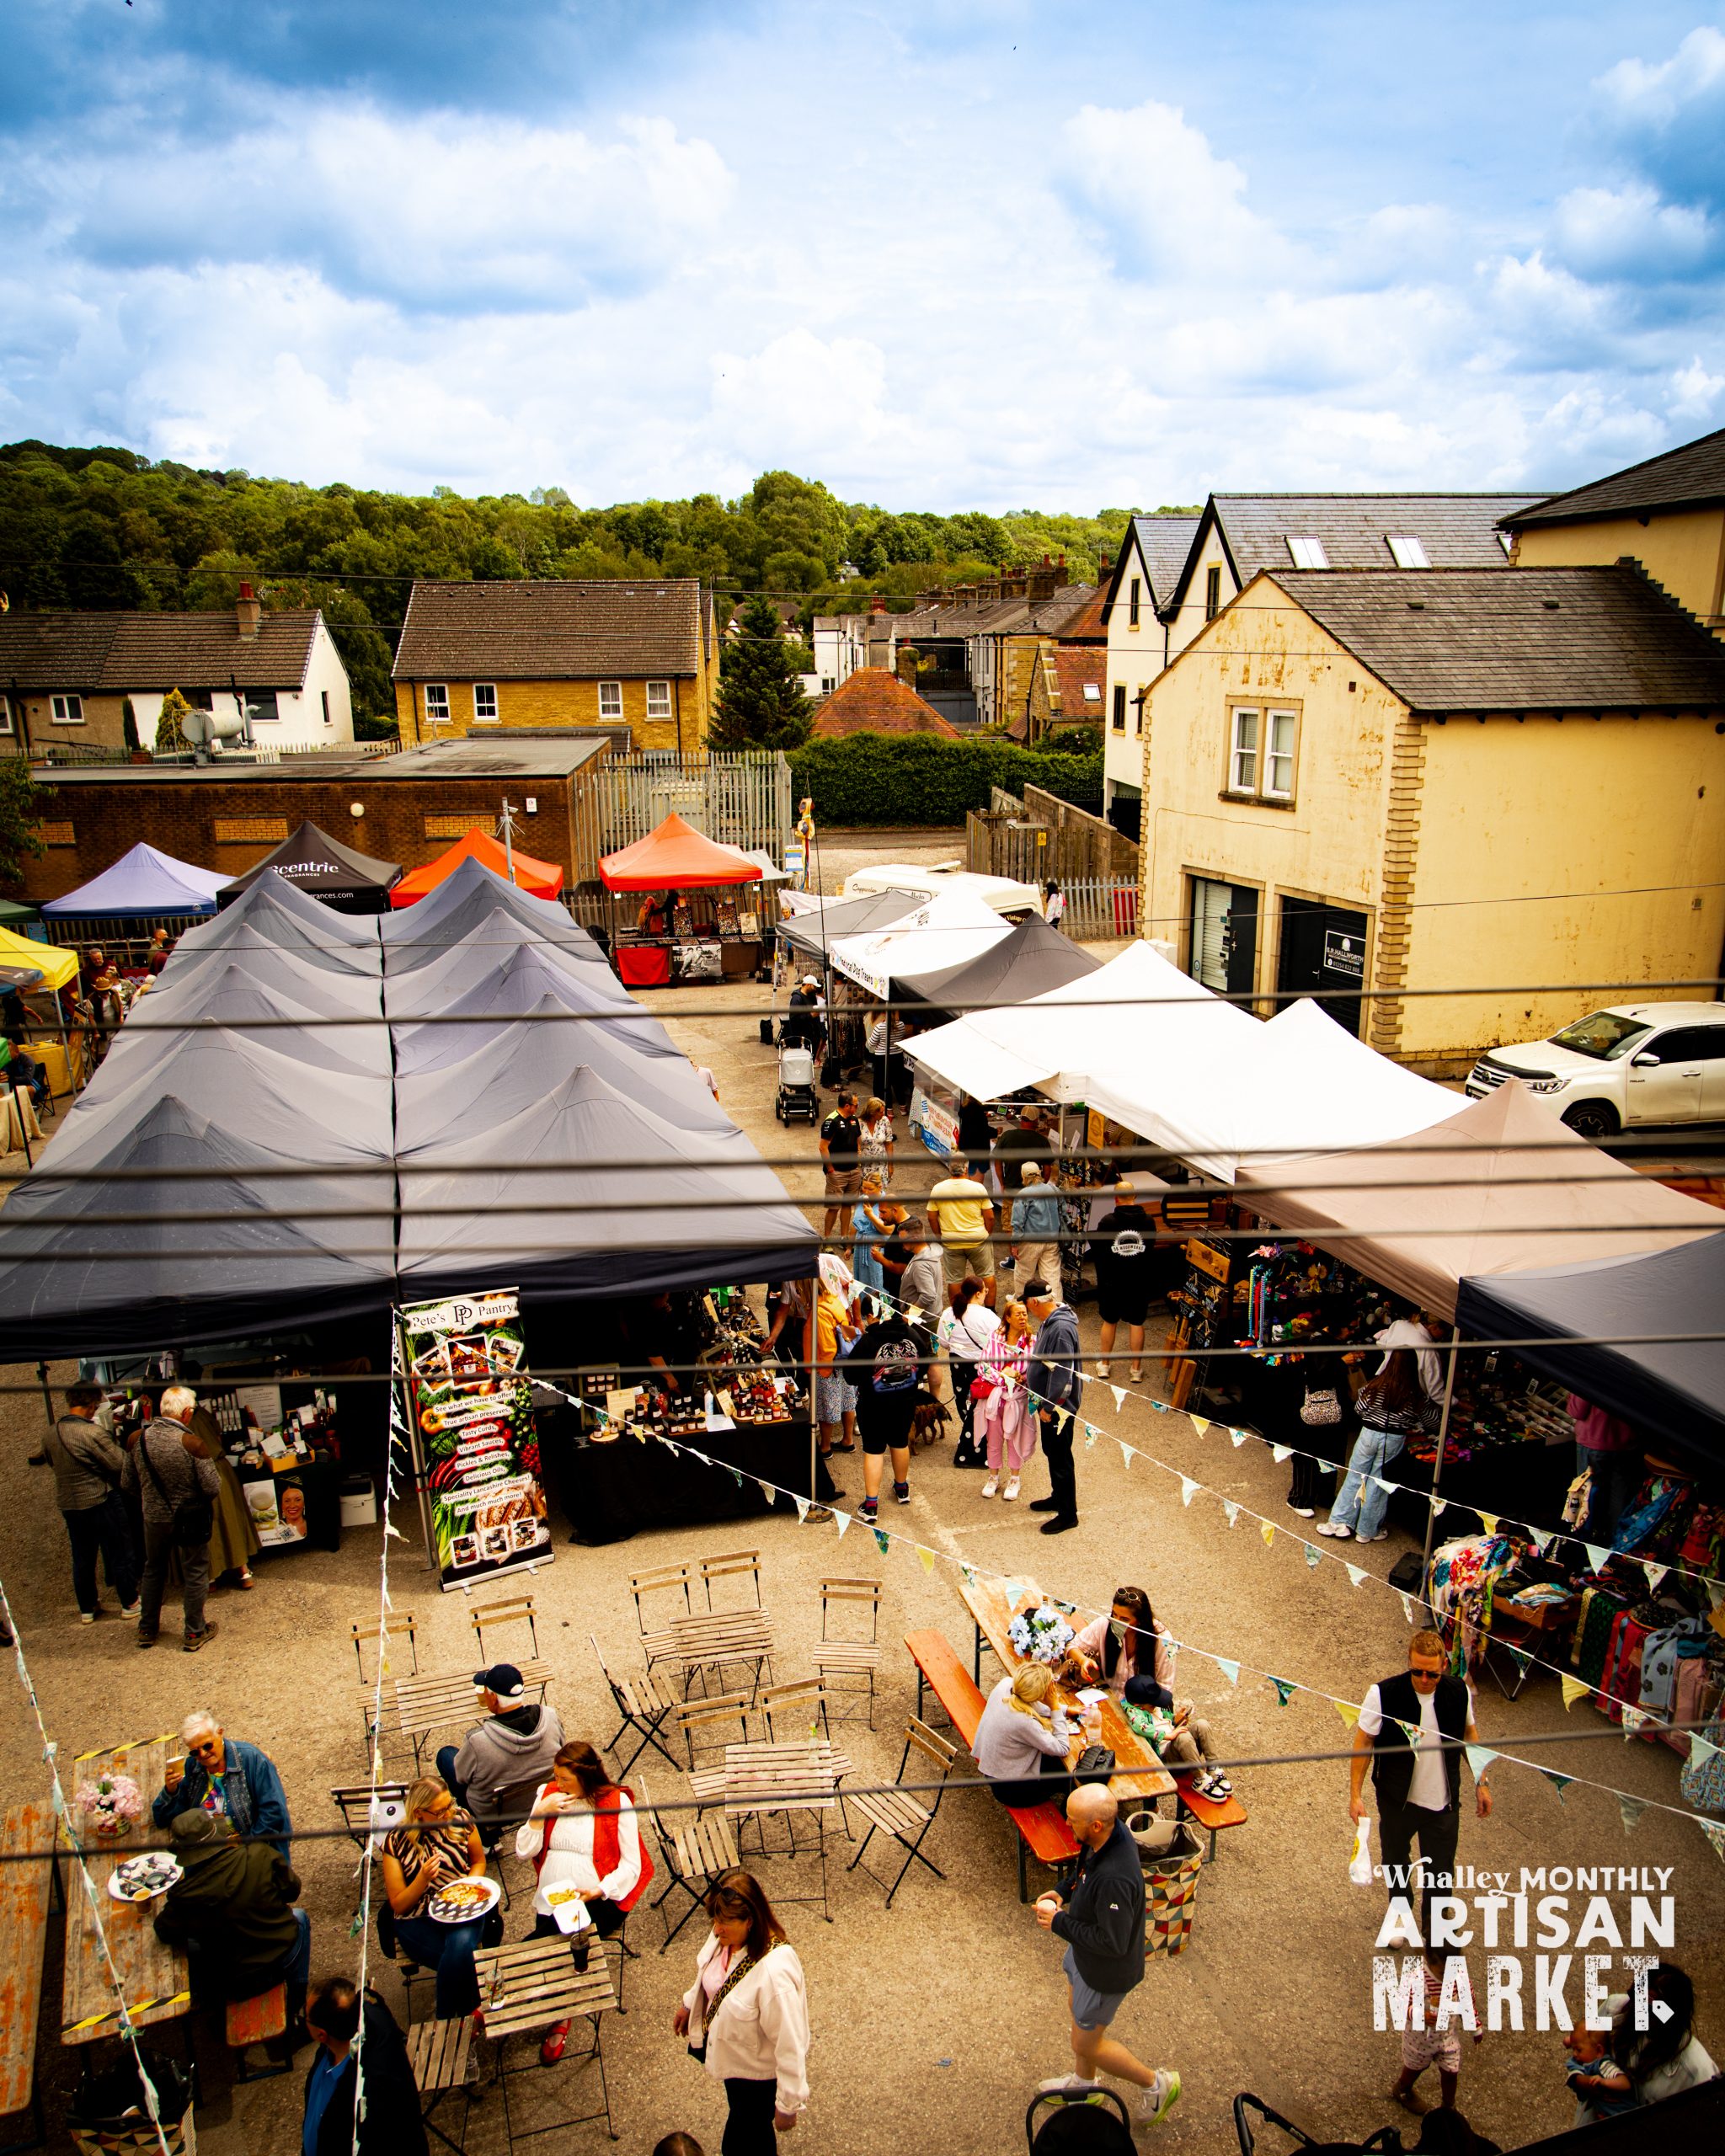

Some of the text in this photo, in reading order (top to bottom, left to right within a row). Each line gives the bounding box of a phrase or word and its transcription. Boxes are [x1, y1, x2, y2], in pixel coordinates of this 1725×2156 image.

[861, 968, 873, 985] Treats
[413, 1313, 446, 1327] Pete's
[478, 1303, 514, 1316] Pantry
[448, 1402, 463, 1411] what
[474, 1396, 489, 1405] have
[498, 1390, 514, 1400] offer!
[458, 1413, 478, 1423] artisan
[479, 1408, 510, 1418] preserves,
[462, 1425, 497, 1438] Tasty Curds,
[459, 1438, 504, 1453] Vibrant Sauces,
[457, 1459, 478, 1468] Pickles
[484, 1453, 510, 1462] Relishes,
[465, 1470, 492, 1481] Delicious
[444, 1476, 530, 1502] Speciality Lancashire Cheeses!
[470, 1501, 487, 1510] much
[487, 1496, 504, 1505] much
[504, 1492, 522, 1501] more!
